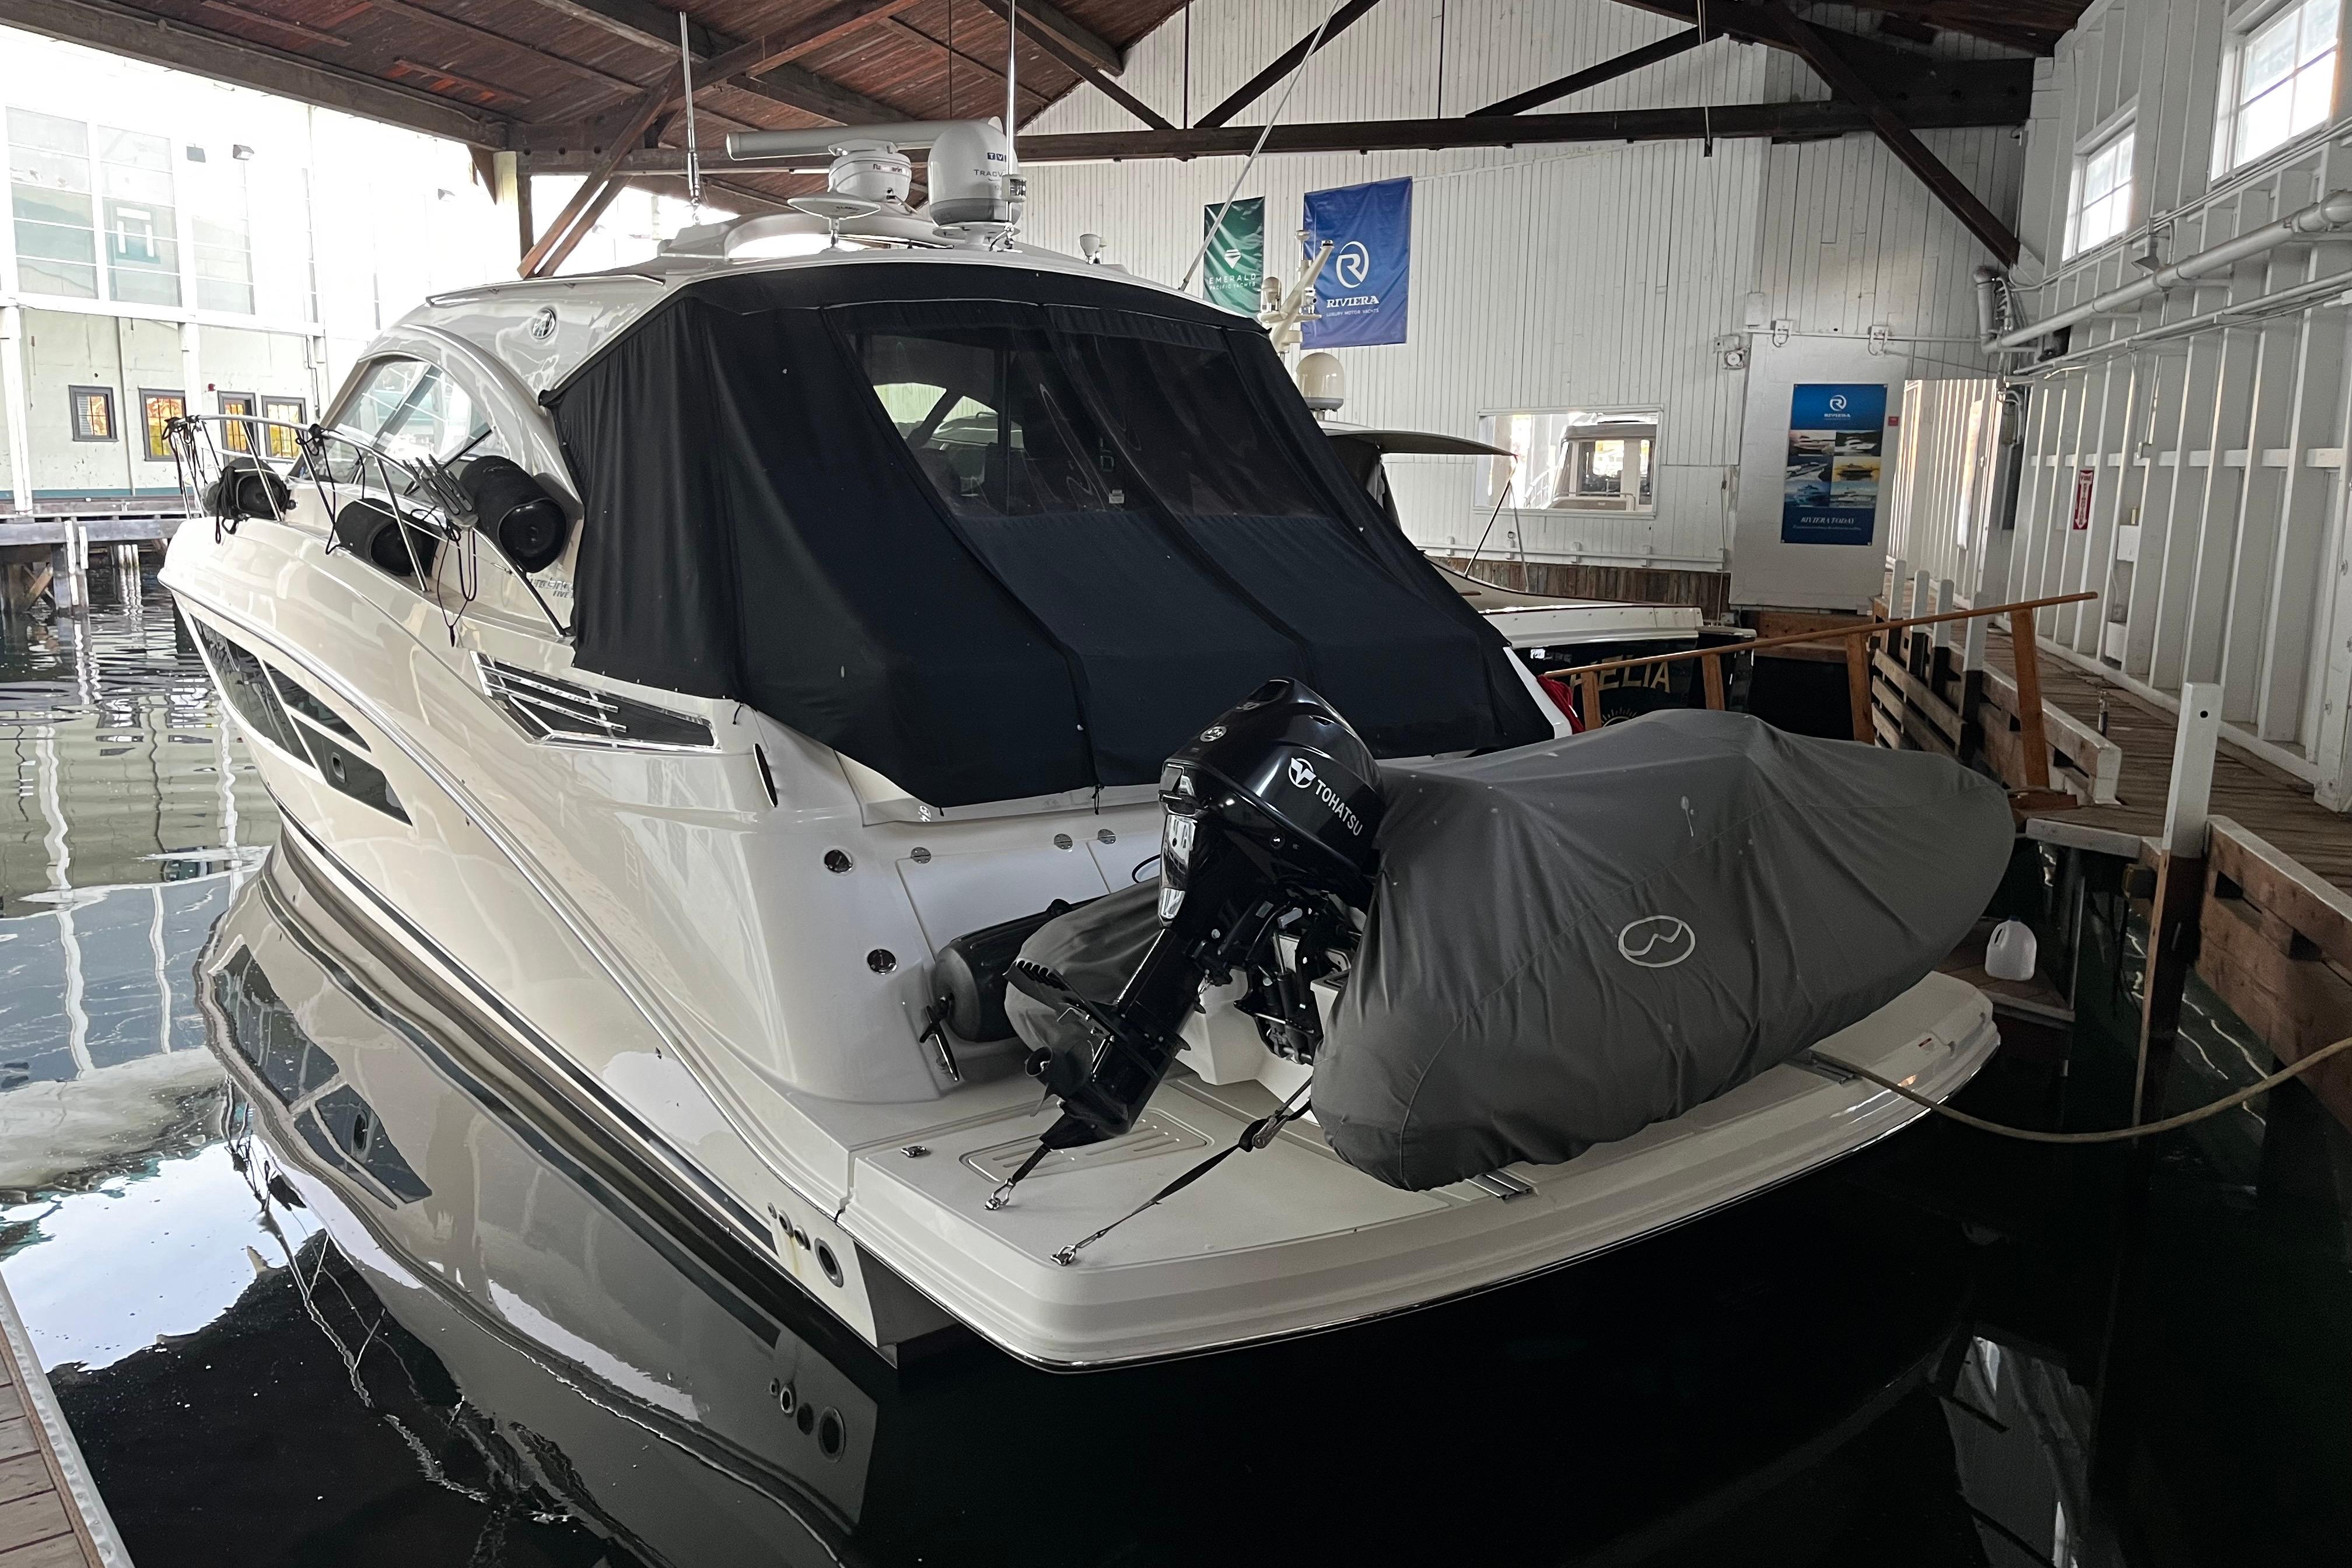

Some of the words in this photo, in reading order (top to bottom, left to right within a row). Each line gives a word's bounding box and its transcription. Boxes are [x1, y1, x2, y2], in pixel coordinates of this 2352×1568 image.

[974, 169, 1003, 177] TRACV
[1209, 272, 1256, 285] EMERALD
[1326, 295, 1380, 308] RIVIERA
[1315, 779, 1363, 836] TOHATSU
